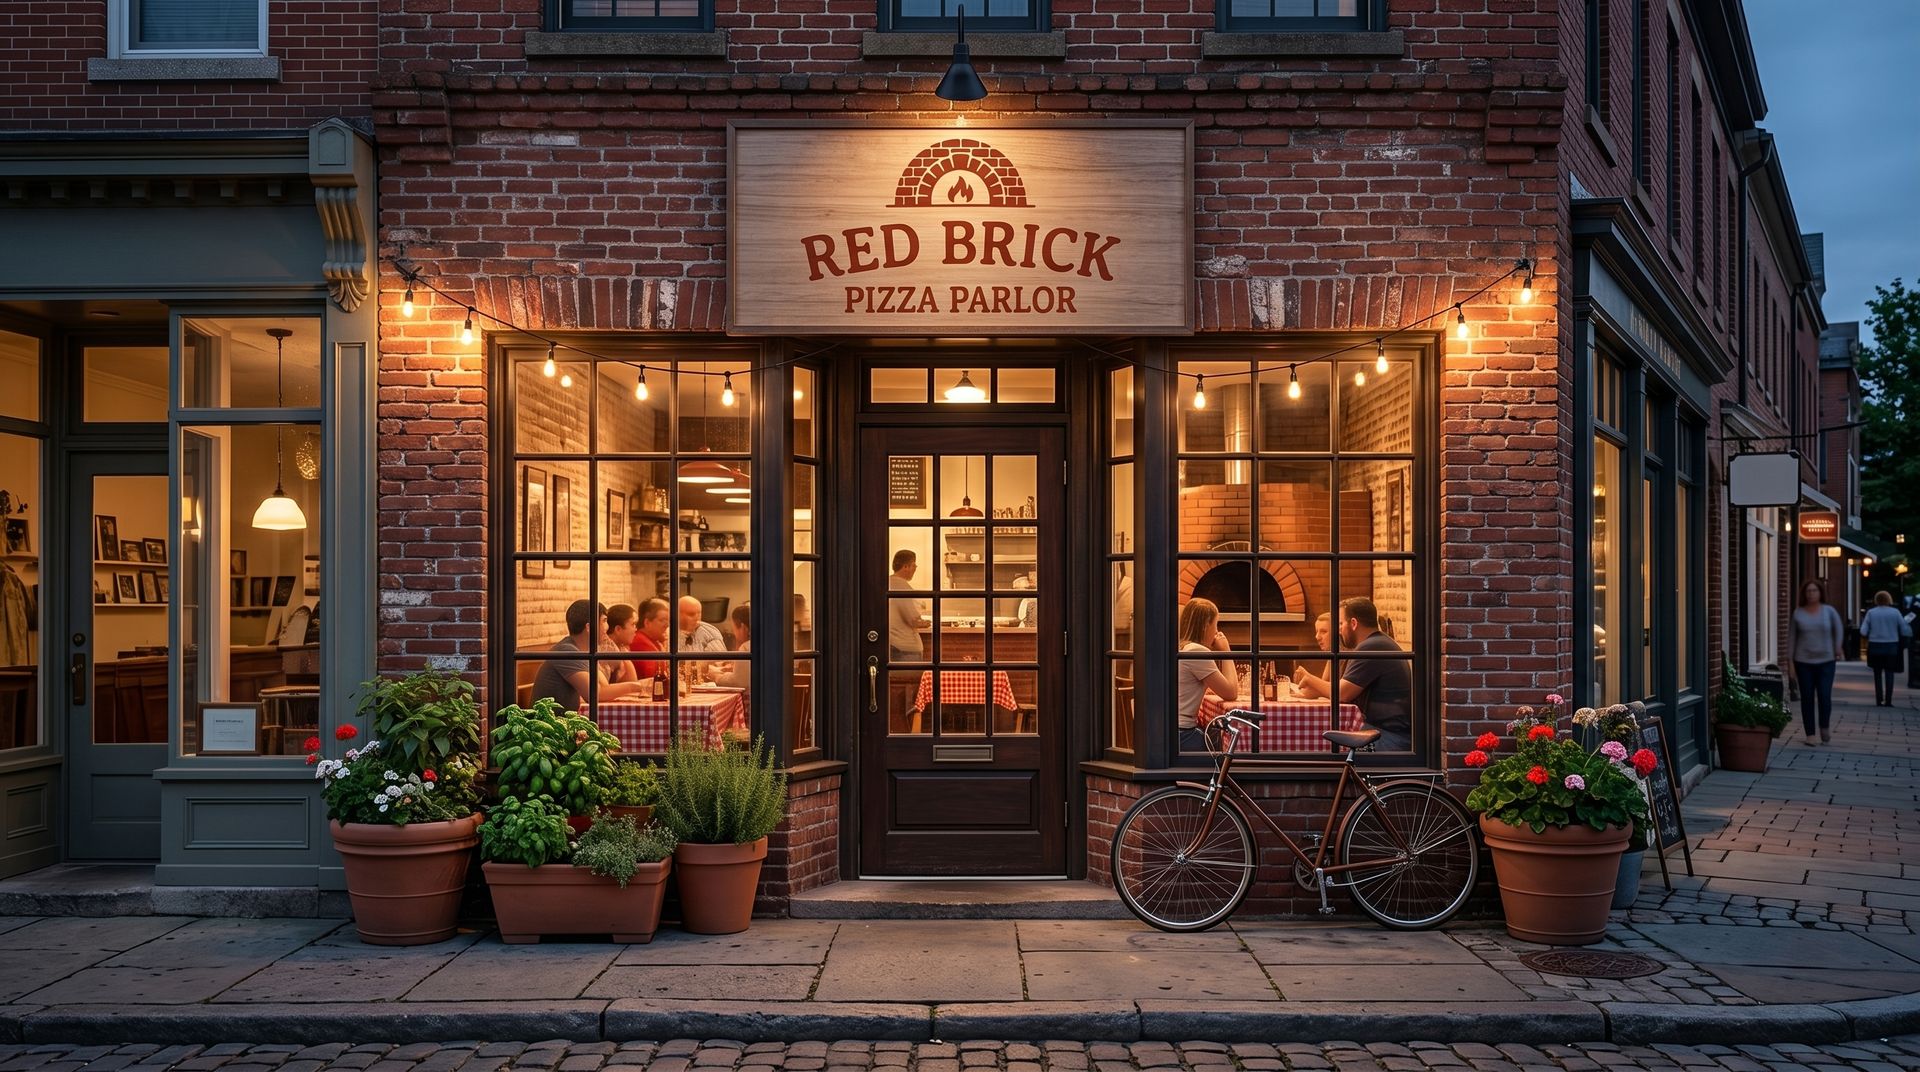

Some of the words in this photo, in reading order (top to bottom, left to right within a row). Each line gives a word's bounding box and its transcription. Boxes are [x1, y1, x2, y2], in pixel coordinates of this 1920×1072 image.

[800, 223, 920, 281] RED
[941, 220, 1122, 282] BRICK
[844, 286, 940, 314] PIZZA
[949, 285, 1078, 314] PARLOR
